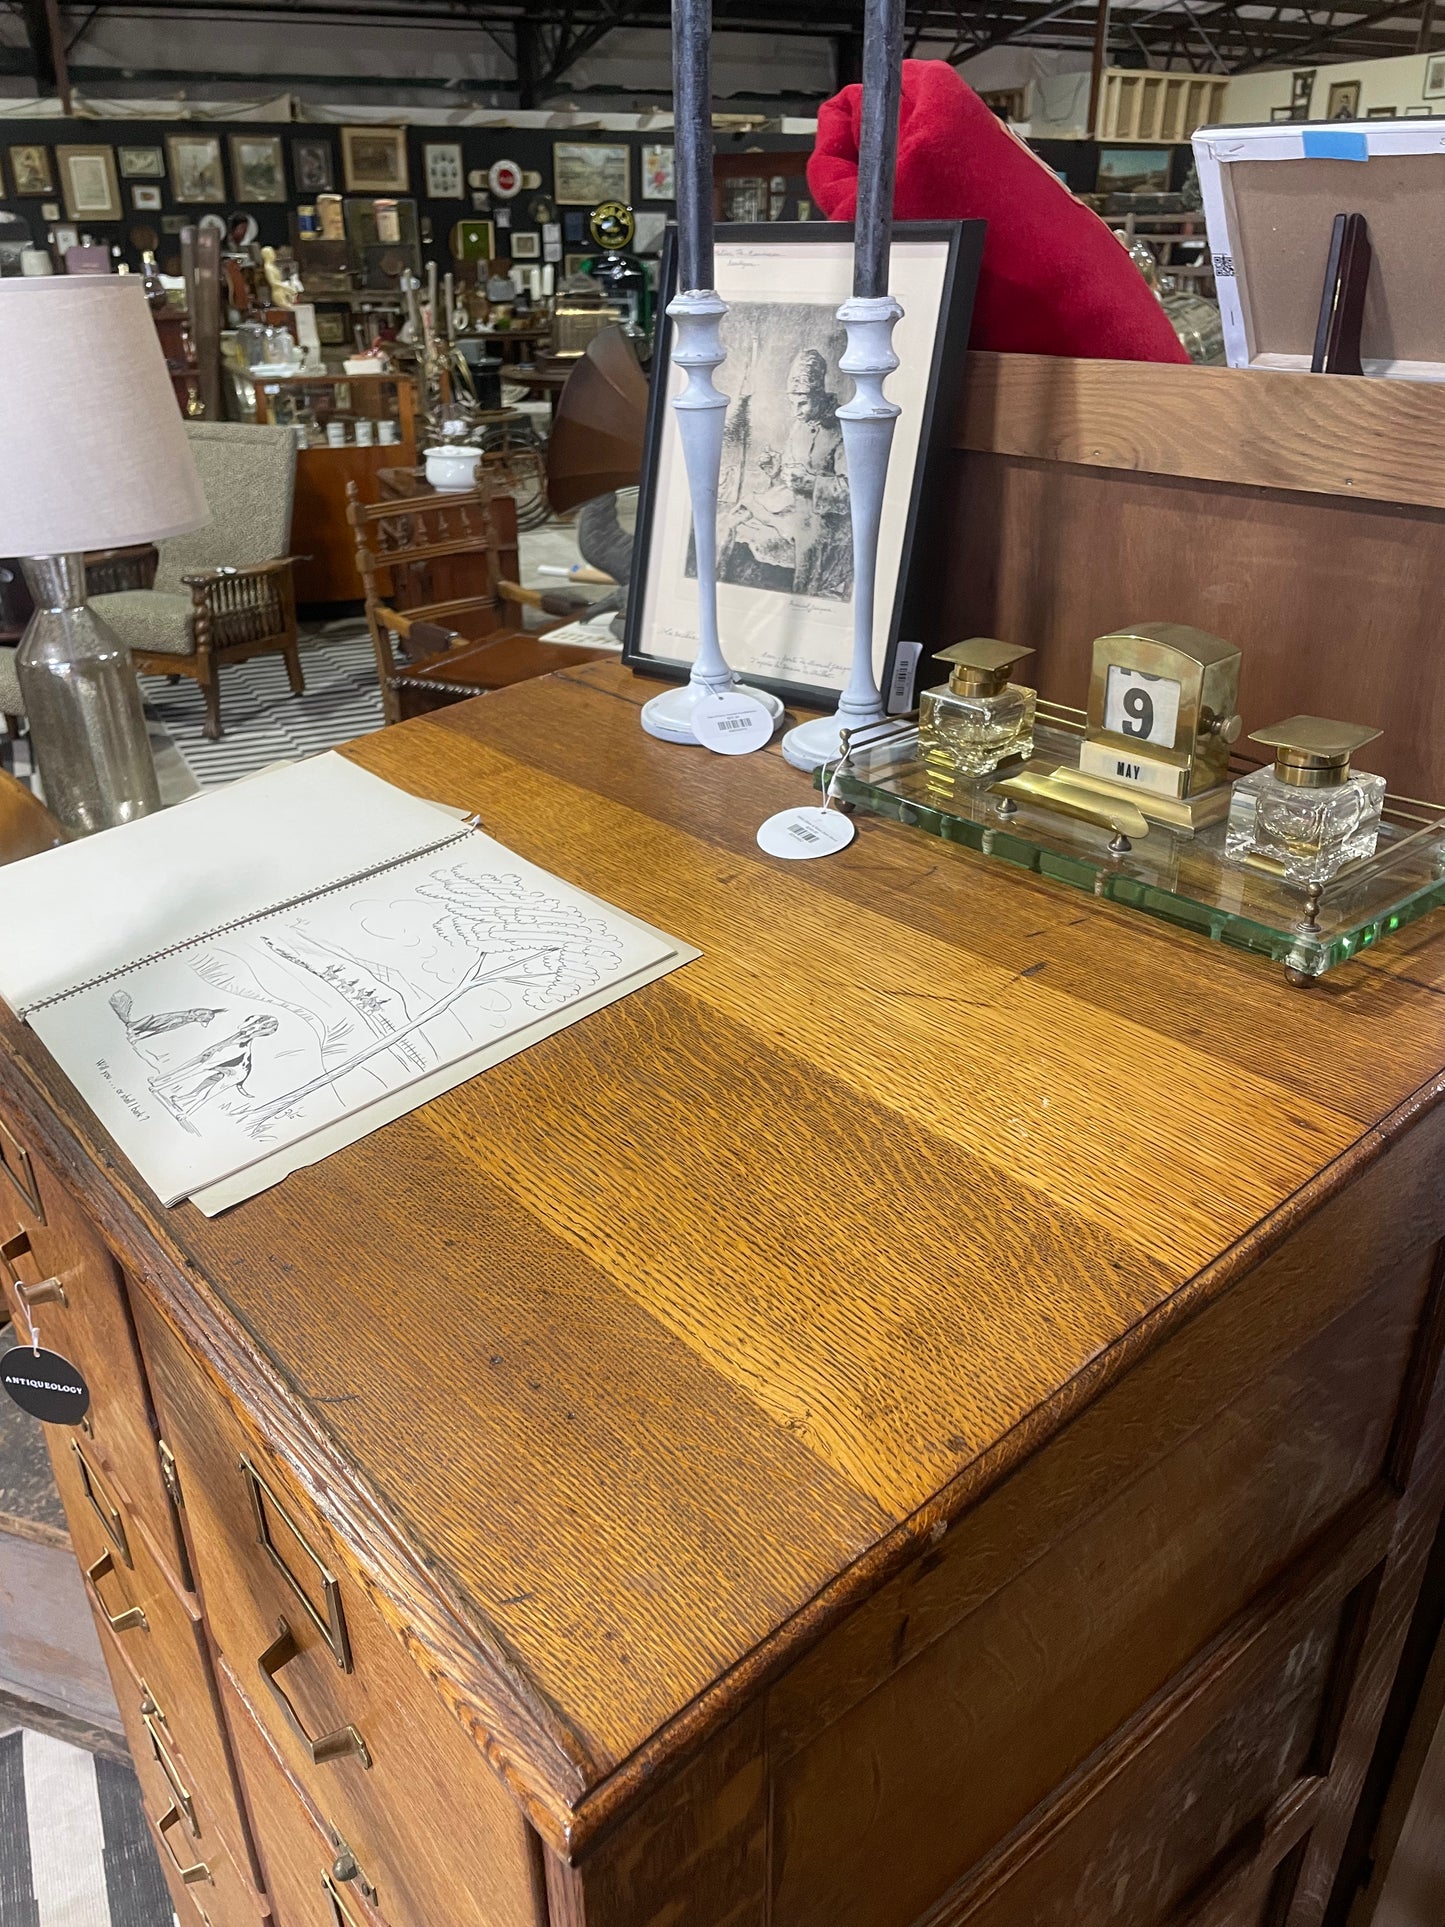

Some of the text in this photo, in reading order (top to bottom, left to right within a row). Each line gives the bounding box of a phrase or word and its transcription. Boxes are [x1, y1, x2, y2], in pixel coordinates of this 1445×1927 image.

[1122, 687, 1154, 740] 9
[1116, 761, 1141, 781] MAY
[5, 1375, 83, 1395] ANTIQUEOLOGY
